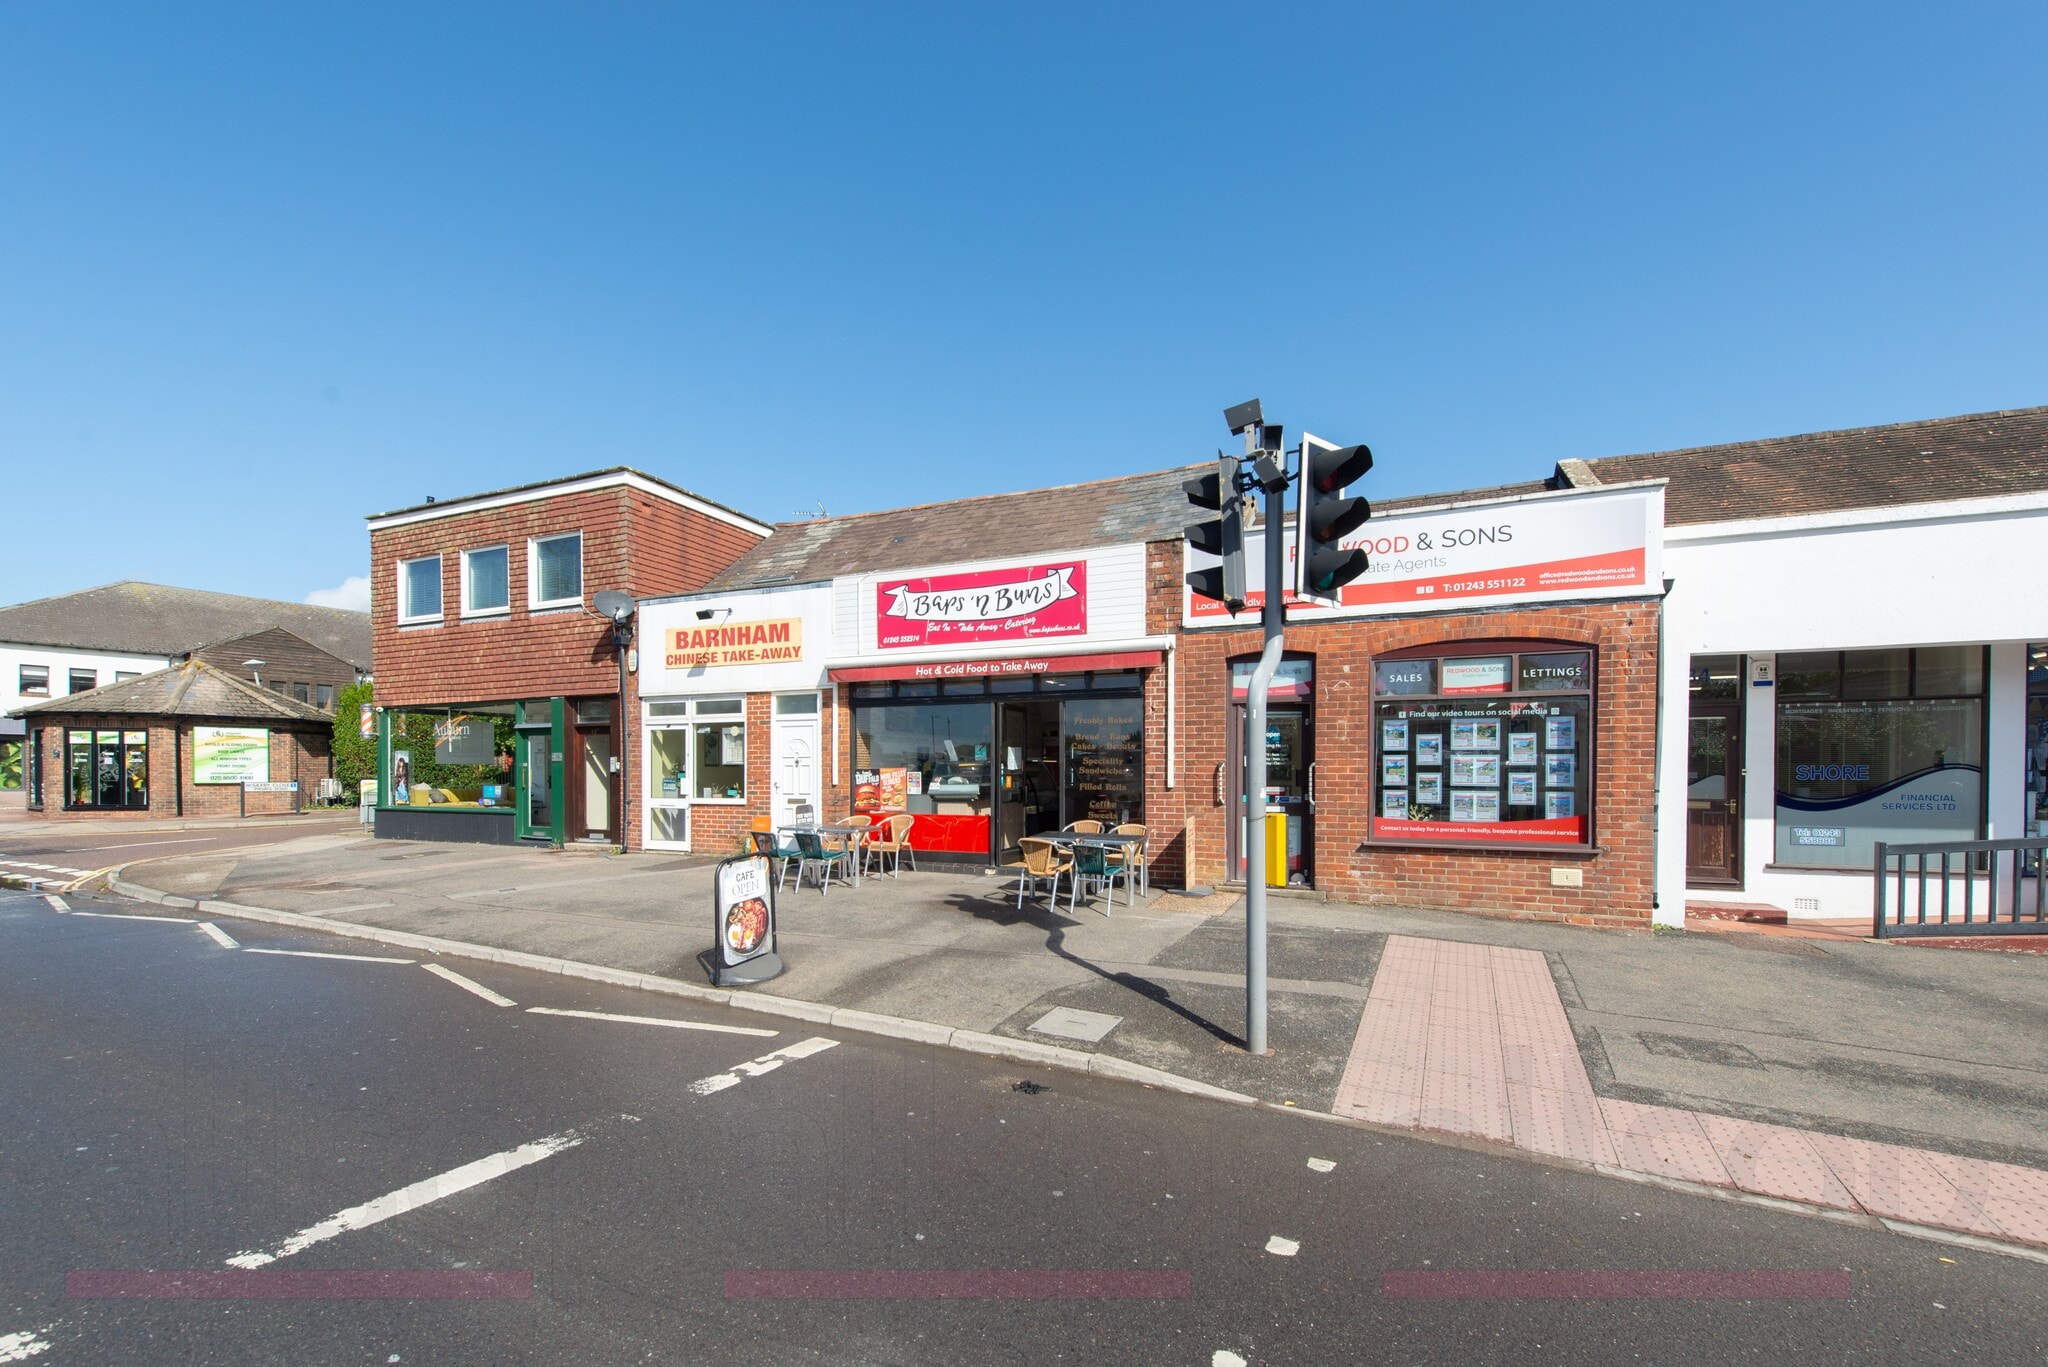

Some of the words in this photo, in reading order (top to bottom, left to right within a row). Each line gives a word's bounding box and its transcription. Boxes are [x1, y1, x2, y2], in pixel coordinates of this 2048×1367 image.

[1417, 532, 1433, 550] &
[1441, 525, 1513, 548] SONS
[1363, 560, 1390, 574] ate
[1393, 555, 1447, 574] Agents
[1539, 566, 1636, 579] office@redwoodandsons.co.uk
[1454, 580, 1485, 592] 01243
[1486, 577, 1526, 589] 551122
[1539, 573, 1636, 585] www.redwoodandsons.co.uk
[912, 594, 965, 617] Baps
[995, 582, 1053, 613] Buns
[1196, 601, 1219, 611] Local
[927, 622, 941, 632] Eat
[943, 622, 950, 632] In
[958, 622, 974, 632] Take
[976, 622, 997, 632] Away
[1004, 616, 1036, 630] Catering
[676, 622, 790, 650] BARNHAM
[666, 651, 718, 666] CHINESE
[722, 645, 801, 662] TAKE-AWAY
[916, 666, 932, 676] Hot
[934, 665, 942, 675] &
[944, 664, 963, 674] Cold
[966, 663, 987, 673] Food
[990, 664, 1000, 672] to
[1001, 662, 1022, 672] Take
[1024, 660, 1049, 671] Away
[1446, 667, 1480, 675] REDWOOD
[1523, 666, 1582, 678] LETTINGS
[1389, 673, 1423, 683] SALES
[1409, 710, 1426, 718] Find
[1441, 709, 1463, 717] video
[1465, 709, 1485, 717] tours
[1498, 708, 1521, 716] social
[1522, 707, 1548, 716] media
[1074, 716, 1104, 725] Freshly
[1107, 716, 1134, 724] Baked
[432, 721, 470, 736] Auburn
[1071, 742, 1096, 750] Cakes
[1083, 756, 1124, 766] Speciality
[1079, 766, 1129, 775] Sandwiches
[1795, 764, 1870, 781] SHORE
[1079, 782, 1103, 791] Filled
[1105, 782, 1127, 791] Rolls
[1900, 794, 1956, 802] FINANCIAL
[1089, 800, 1117, 809] Coffee
[1881, 802, 1933, 810] SERVICES
[1936, 803, 1956, 811] LTD
[1088, 811, 1117, 819] Sweets
[1519, 828, 1556, 836] professional
[1795, 828, 1811, 836] Tel:
[1812, 828, 1841, 837] 01243
[735, 870, 755, 882] CAFE
[732, 879, 760, 896] OPEN
